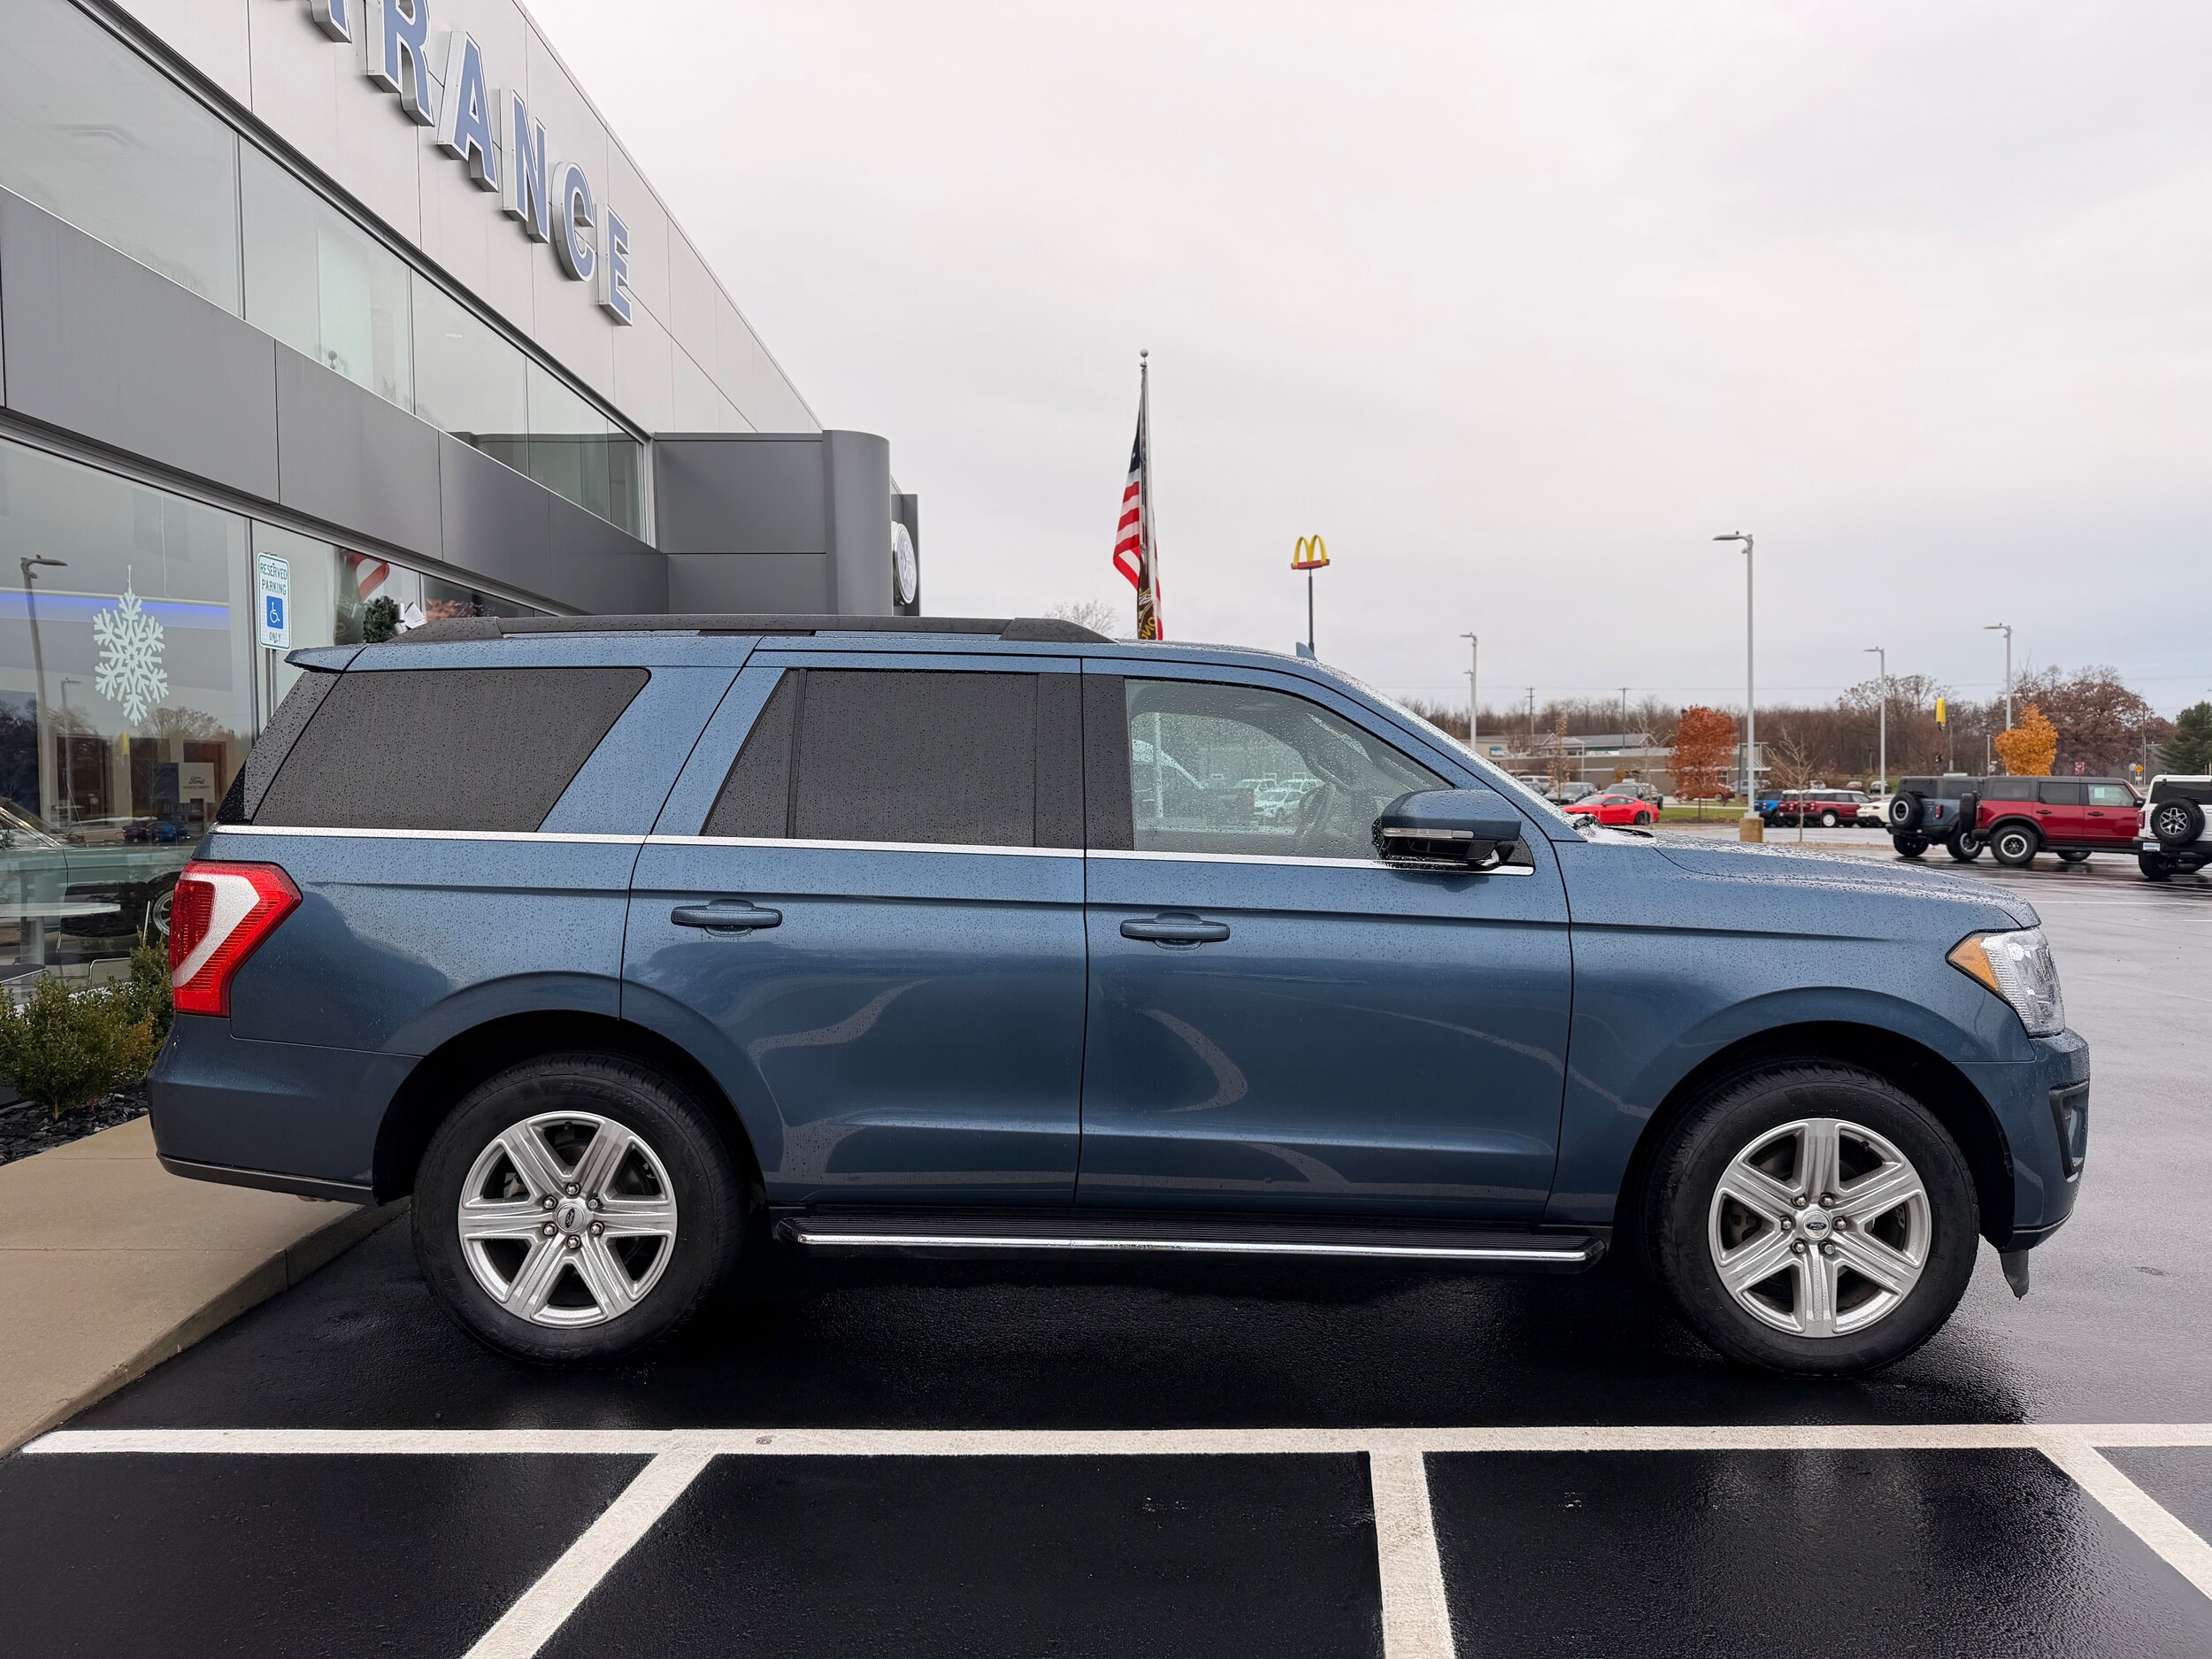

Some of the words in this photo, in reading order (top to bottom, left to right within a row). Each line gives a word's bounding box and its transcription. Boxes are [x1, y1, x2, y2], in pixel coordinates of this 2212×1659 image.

[311, 0, 633, 326] RANCE
[259, 563, 288, 580] RESERVED
[261, 579, 287, 595] PARKING
[268, 631, 281, 643] ONLY
[188, 776, 205, 785] Ford
